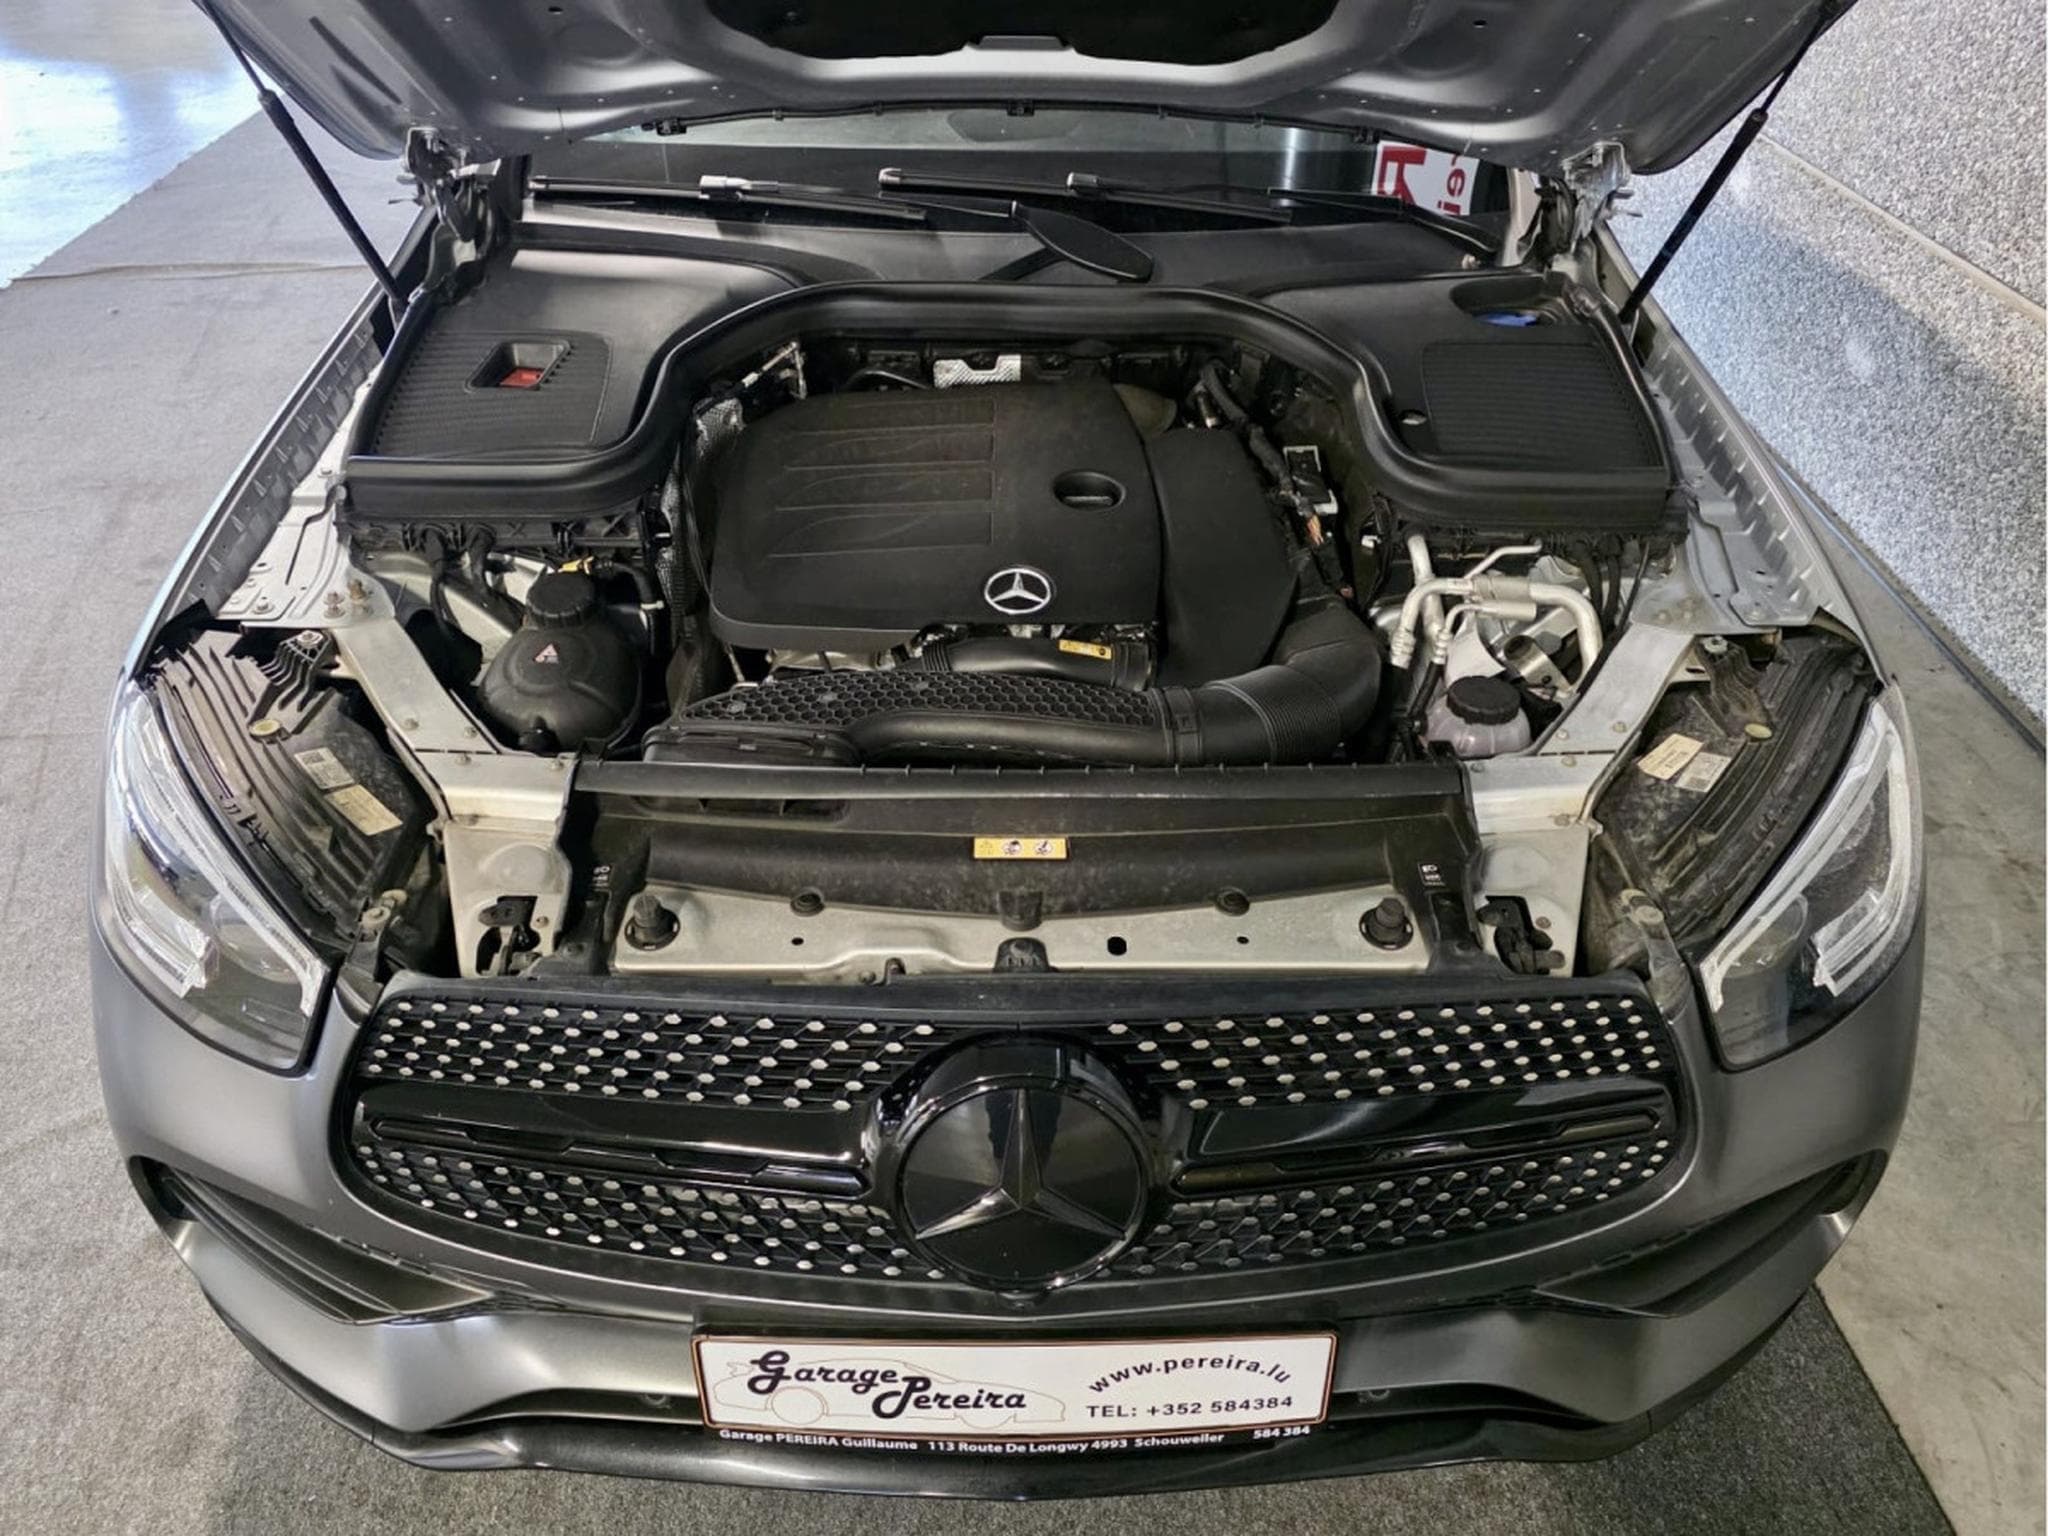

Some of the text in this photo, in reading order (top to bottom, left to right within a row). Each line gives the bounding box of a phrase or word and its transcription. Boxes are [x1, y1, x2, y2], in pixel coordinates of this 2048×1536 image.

[747, 1350, 897, 1395] Garage
[1088, 1354, 1291, 1393] www.pereira.lu
[871, 1375, 1027, 1419] Pereira
[1086, 1396, 1293, 1418] TEL: +352 584384
[719, 1429, 773, 1443] Garage
[775, 1433, 839, 1446] PEREIRA
[841, 1436, 918, 1450] Guillaume
[928, 1441, 955, 1451] 113
[958, 1441, 1003, 1453] Route
[1005, 1442, 1027, 1453] De
[1029, 1440, 1089, 1453] Longwy
[1091, 1438, 1127, 1450] 4993
[1134, 1433, 1225, 1448] Schouweiler
